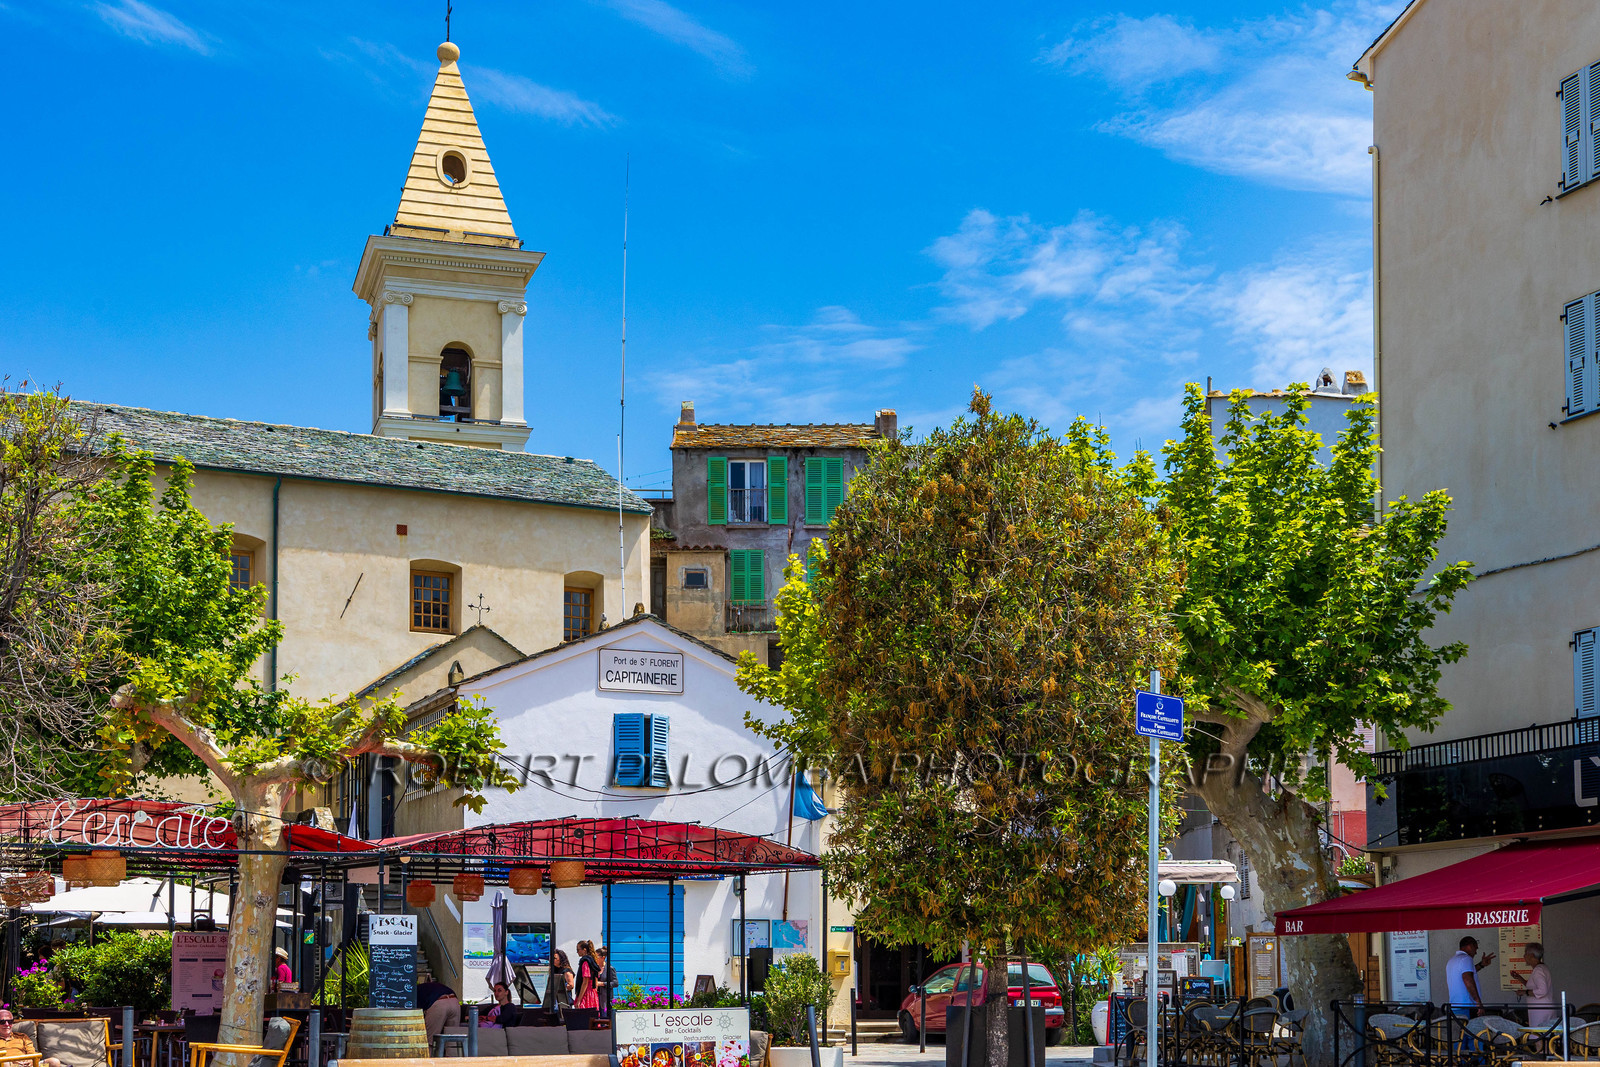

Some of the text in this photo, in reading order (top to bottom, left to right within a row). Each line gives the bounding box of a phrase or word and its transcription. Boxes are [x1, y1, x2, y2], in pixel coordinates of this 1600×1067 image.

[614, 656, 627, 665] Port
[650, 659, 679, 668] FLORENT
[605, 670, 677, 686] CAPITAINERIE
[1465, 909, 1529, 926] BRASSERIE
[1285, 920, 1304, 933] BAR
[177, 936, 217, 944] L'ESCALE
[653, 1012, 713, 1027] L'escale
